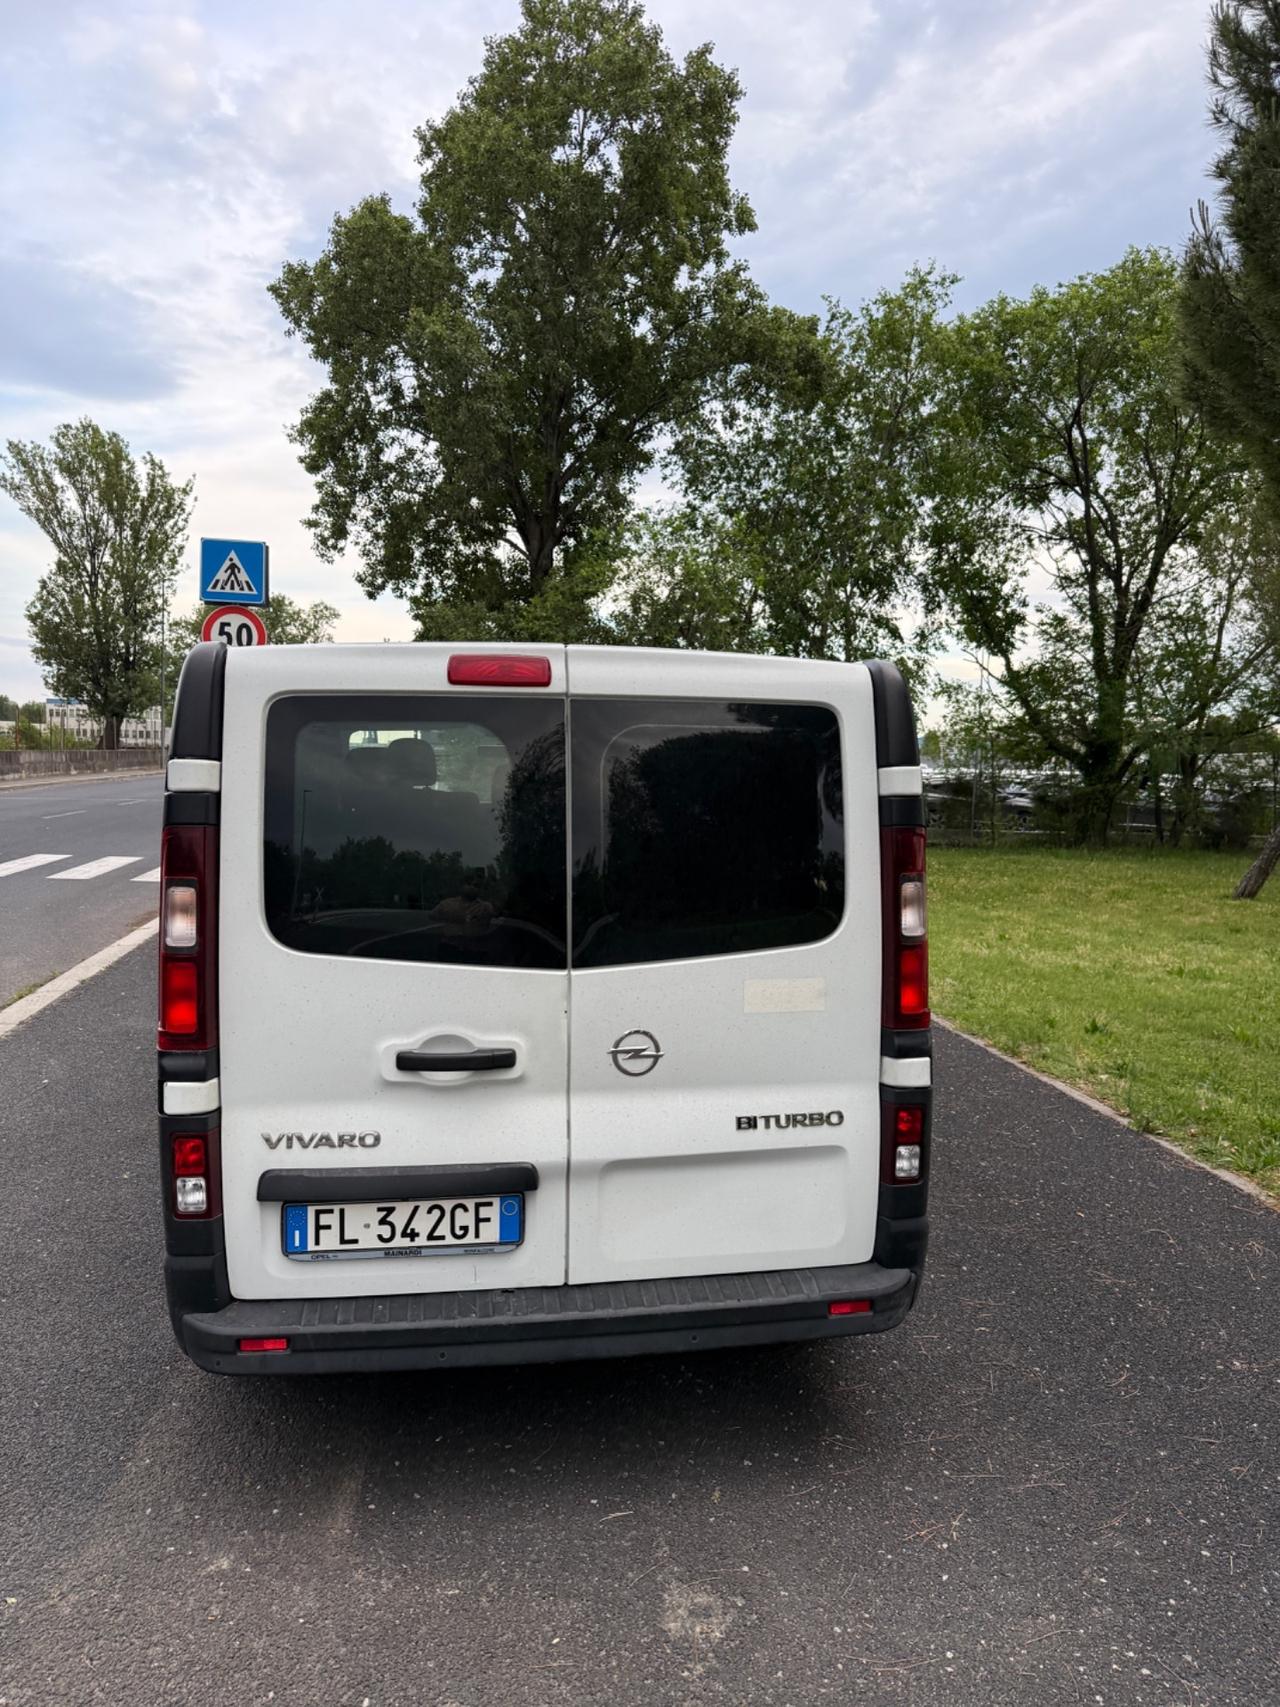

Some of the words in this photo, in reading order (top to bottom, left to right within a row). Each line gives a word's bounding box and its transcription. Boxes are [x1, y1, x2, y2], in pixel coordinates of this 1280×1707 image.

[218, 621, 253, 647] 50
[735, 1110, 845, 1131] BITURBO
[260, 1131, 381, 1150] VIVARO
[314, 1207, 359, 1247] FL
[375, 1201, 494, 1244] 342GF
